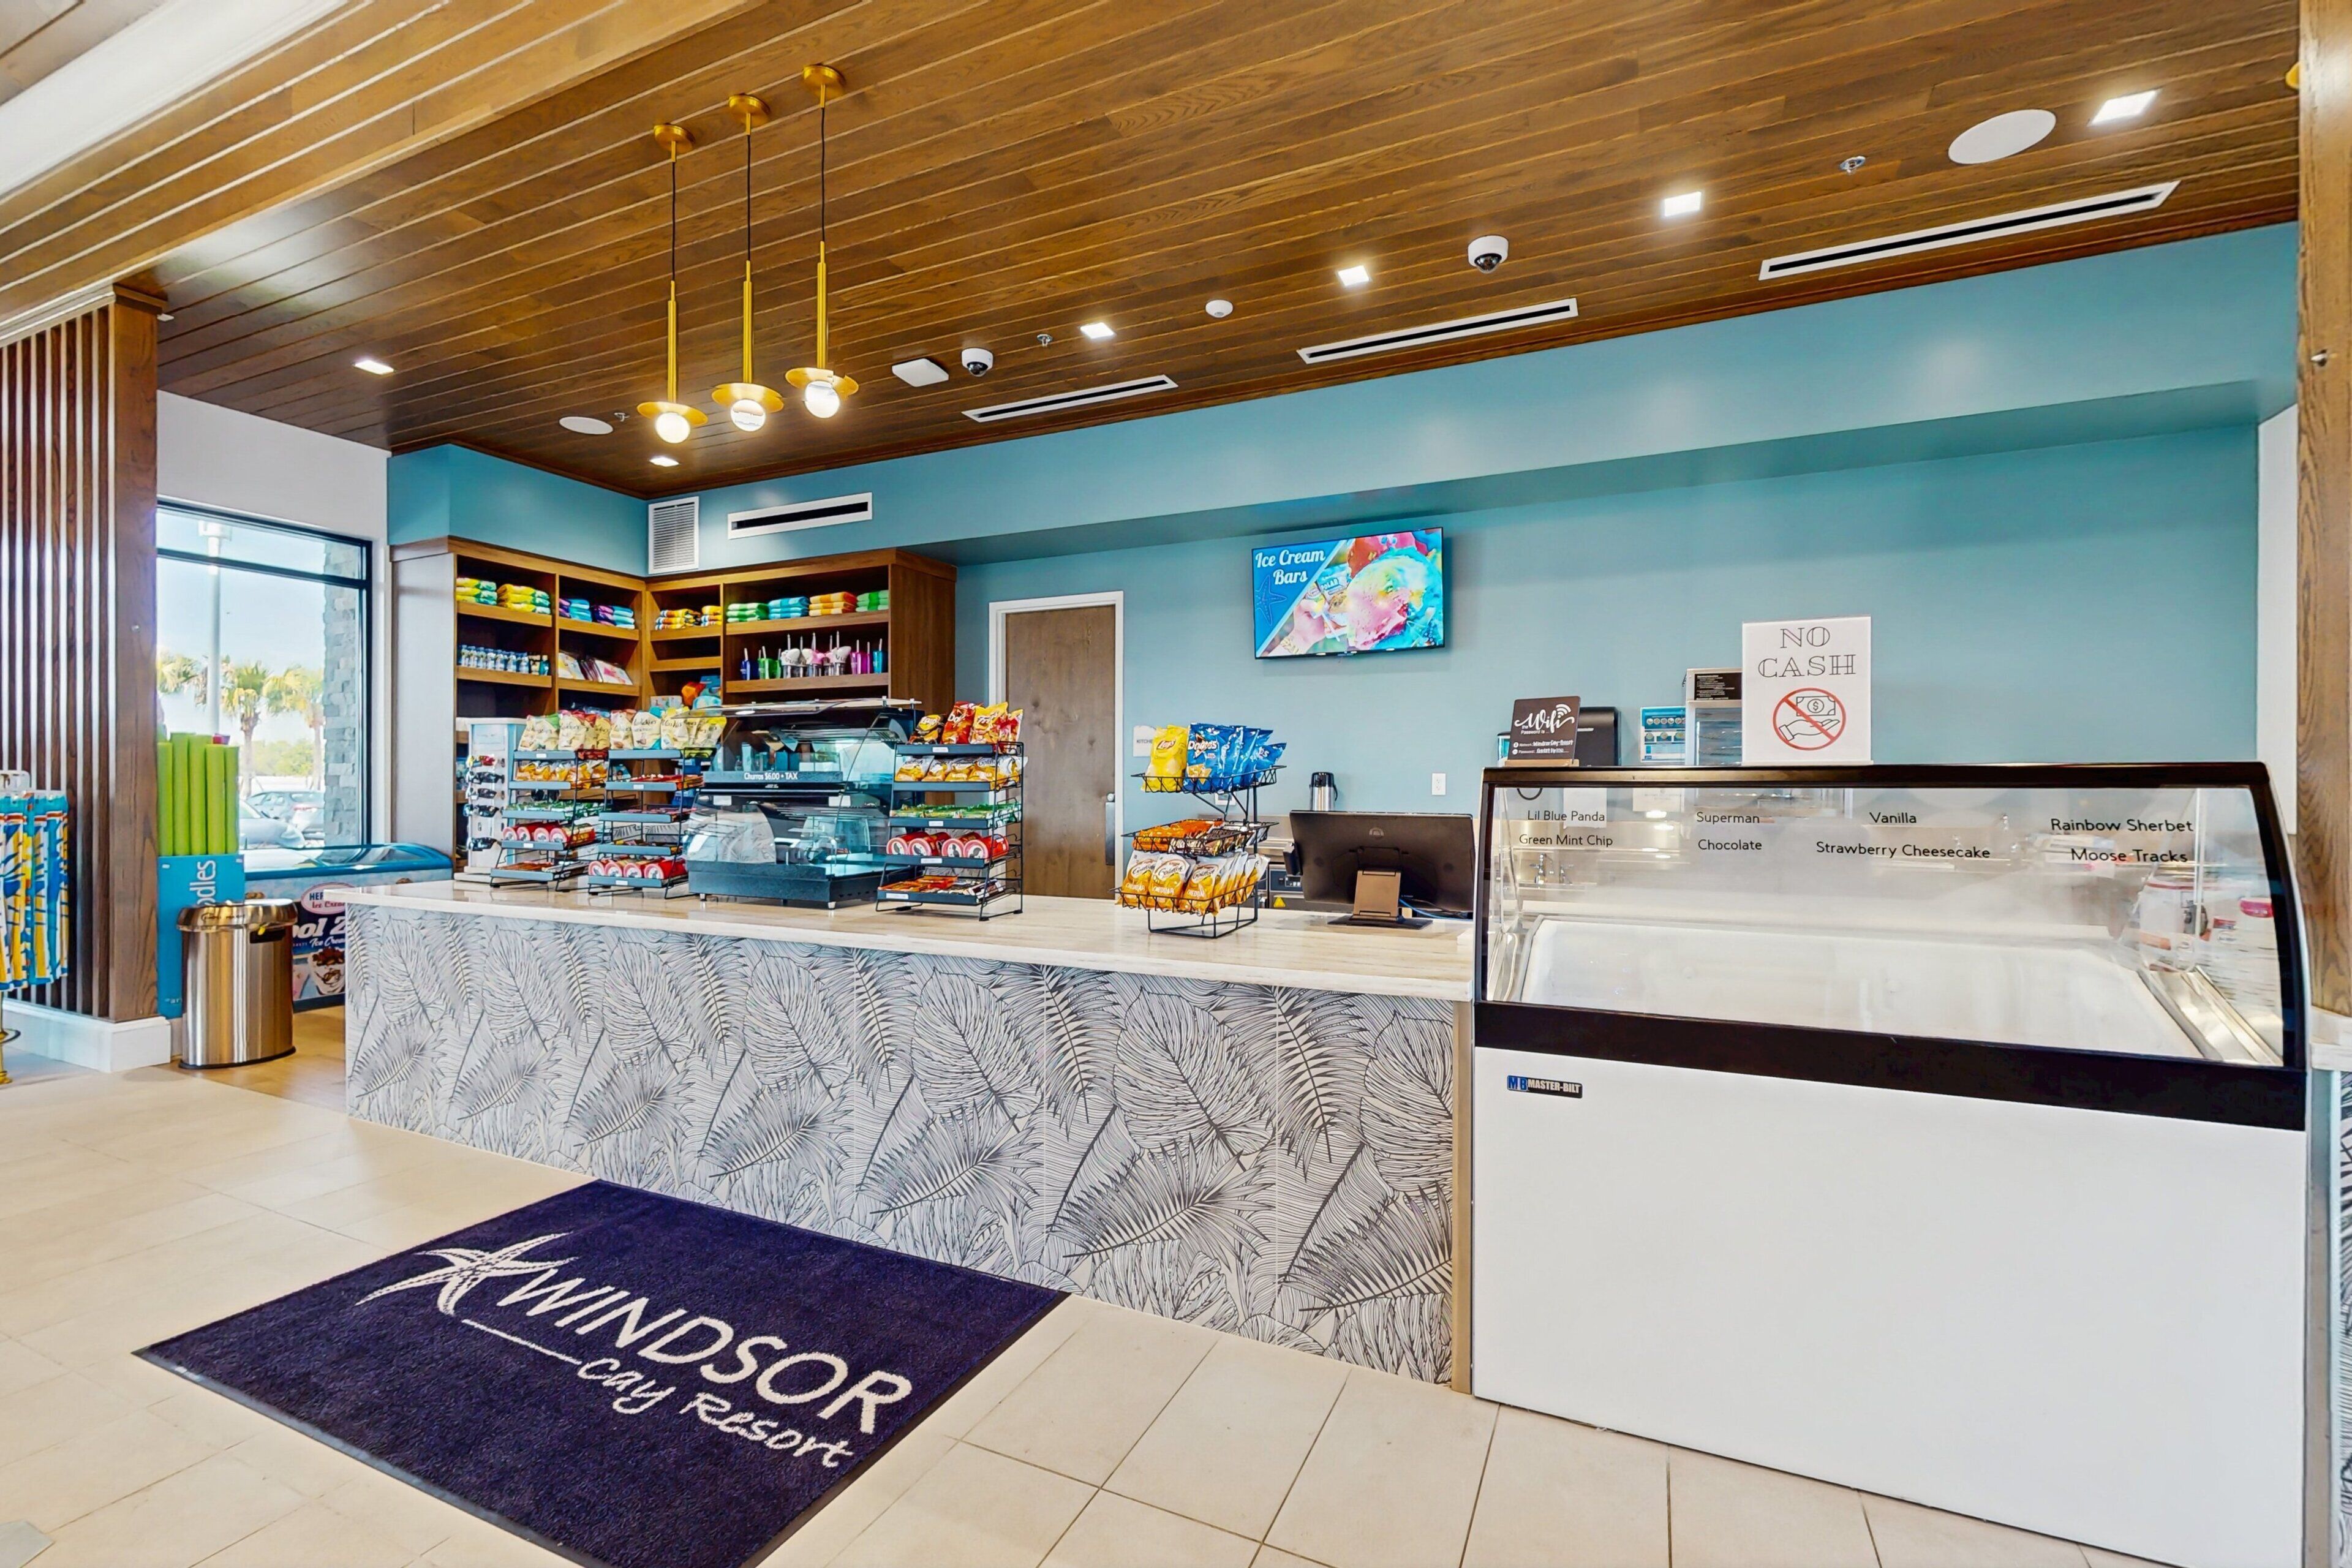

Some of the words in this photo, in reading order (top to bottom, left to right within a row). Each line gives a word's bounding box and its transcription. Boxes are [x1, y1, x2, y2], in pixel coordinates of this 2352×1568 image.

[1255, 552, 1275, 568] Ice
[1278, 549, 1325, 566] Cream
[1273, 569, 1308, 585] Bars
[1780, 626, 1831, 649] NO
[1758, 654, 1857, 678] CASH
[1514, 709, 1575, 733] Wifi
[1188, 740, 1218, 751] Doritos
[765, 772, 780, 780] $6.00
[1527, 810, 1540, 822] Lil
[1544, 810, 1567, 822] Blue
[1570, 810, 1605, 822] Panda
[1696, 812, 1760, 825] Superman
[1869, 812, 1917, 824] Vanilla
[2051, 818, 2121, 832] Rainbow
[2127, 818, 2194, 832] Sherbet
[1519, 834, 1553, 846] Green
[1556, 834, 1585, 846] Mint
[1586, 834, 1613, 849] Chip
[1698, 839, 1762, 851] Chocolate
[1816, 841, 1897, 858] Strawberry
[1901, 844, 1991, 859] Cheesecake
[2071, 848, 2127, 862] Moose
[2132, 850, 2188, 863] Tracks
[190, 860, 216, 906] odles
[1528, 1079, 1581, 1093] MASTER-BILT
[497, 1268, 913, 1434] WINDSOR
[577, 1358, 676, 1414] Cay
[680, 1392, 854, 1468] Resort
